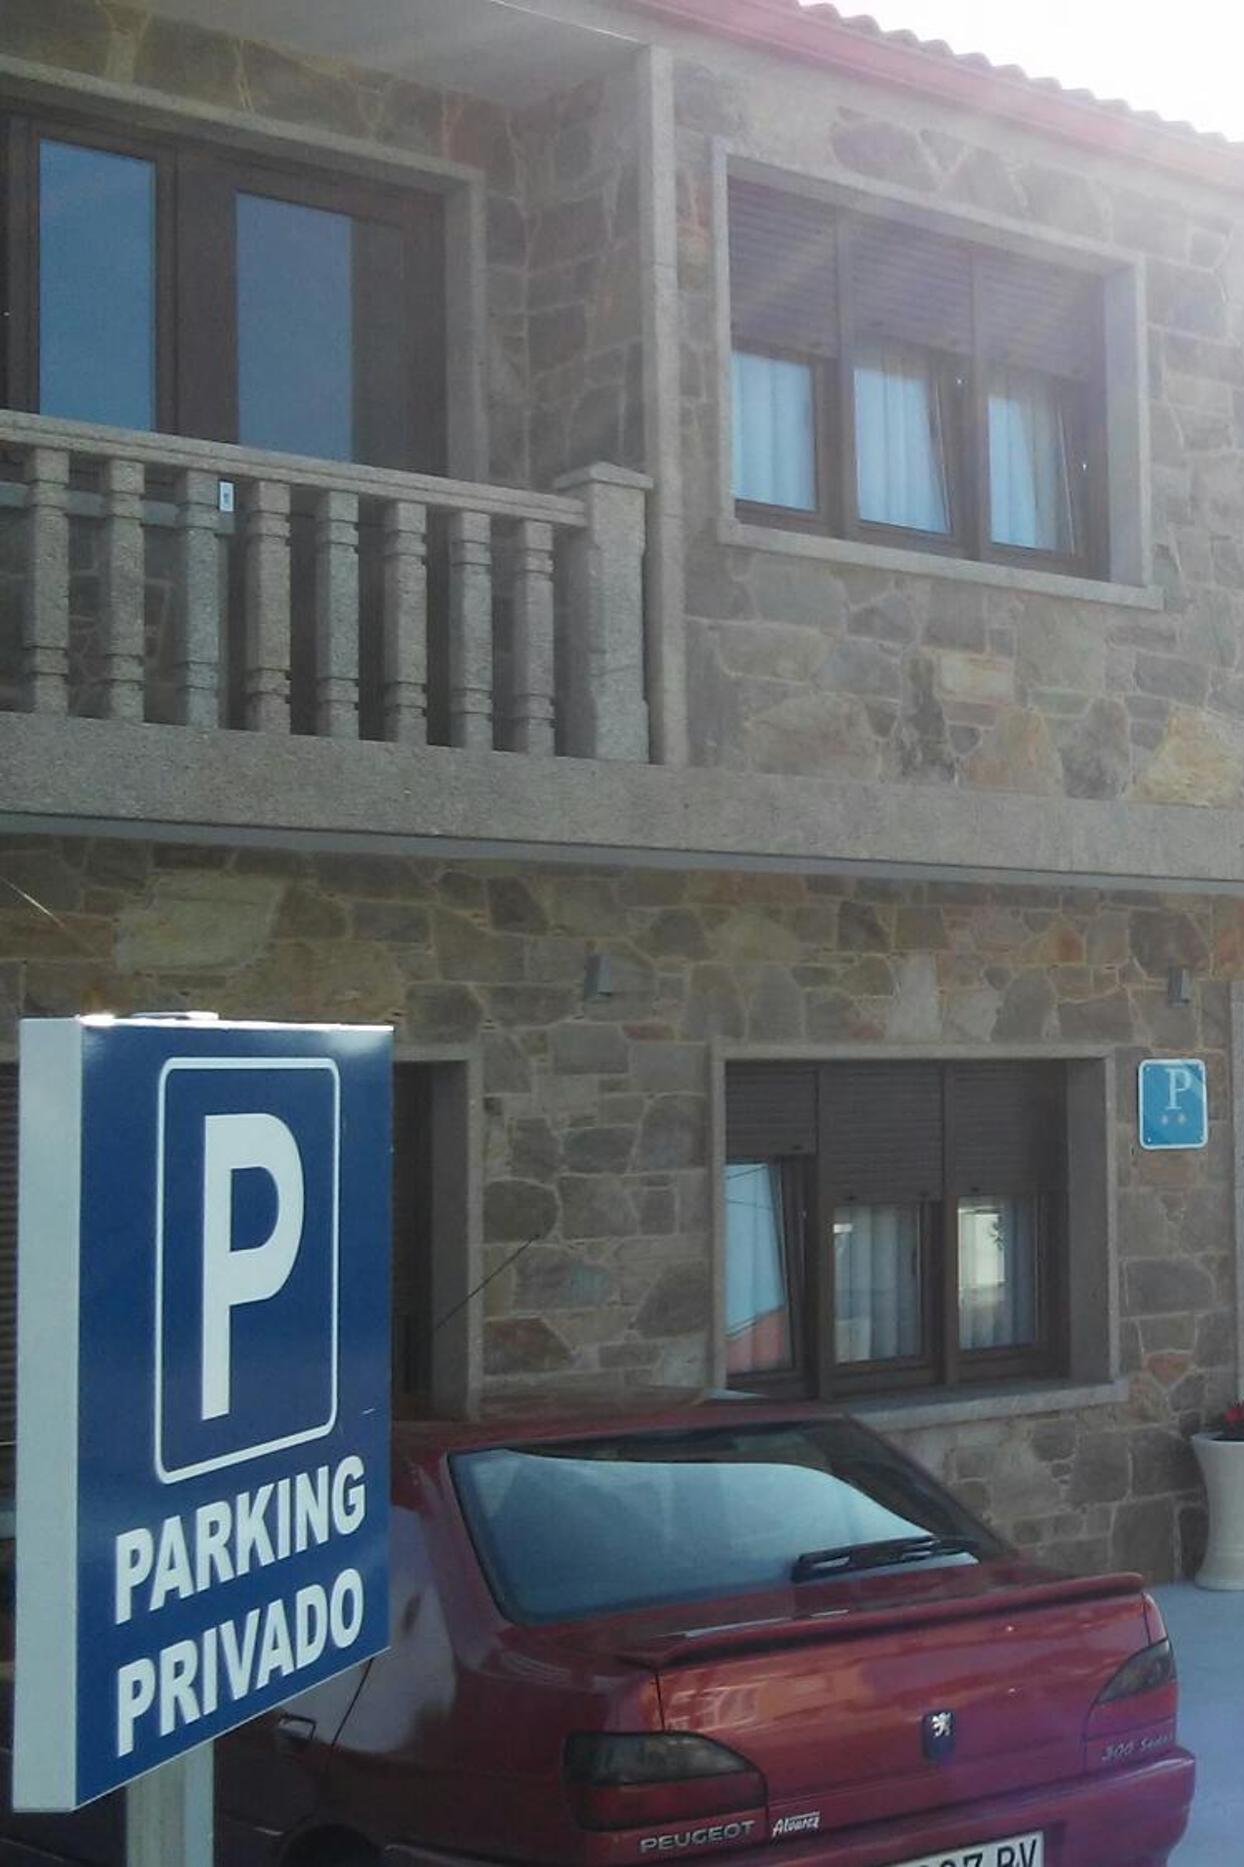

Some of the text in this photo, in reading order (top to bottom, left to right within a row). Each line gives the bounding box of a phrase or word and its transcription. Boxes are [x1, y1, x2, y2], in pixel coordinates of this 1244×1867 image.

[1165, 1068, 1192, 1110] P
[201, 1112, 304, 1421] P
[114, 1455, 365, 1625] PARKING
[116, 1568, 363, 1757] PRIVADO
[639, 1820, 755, 1853] PEUGEOT
